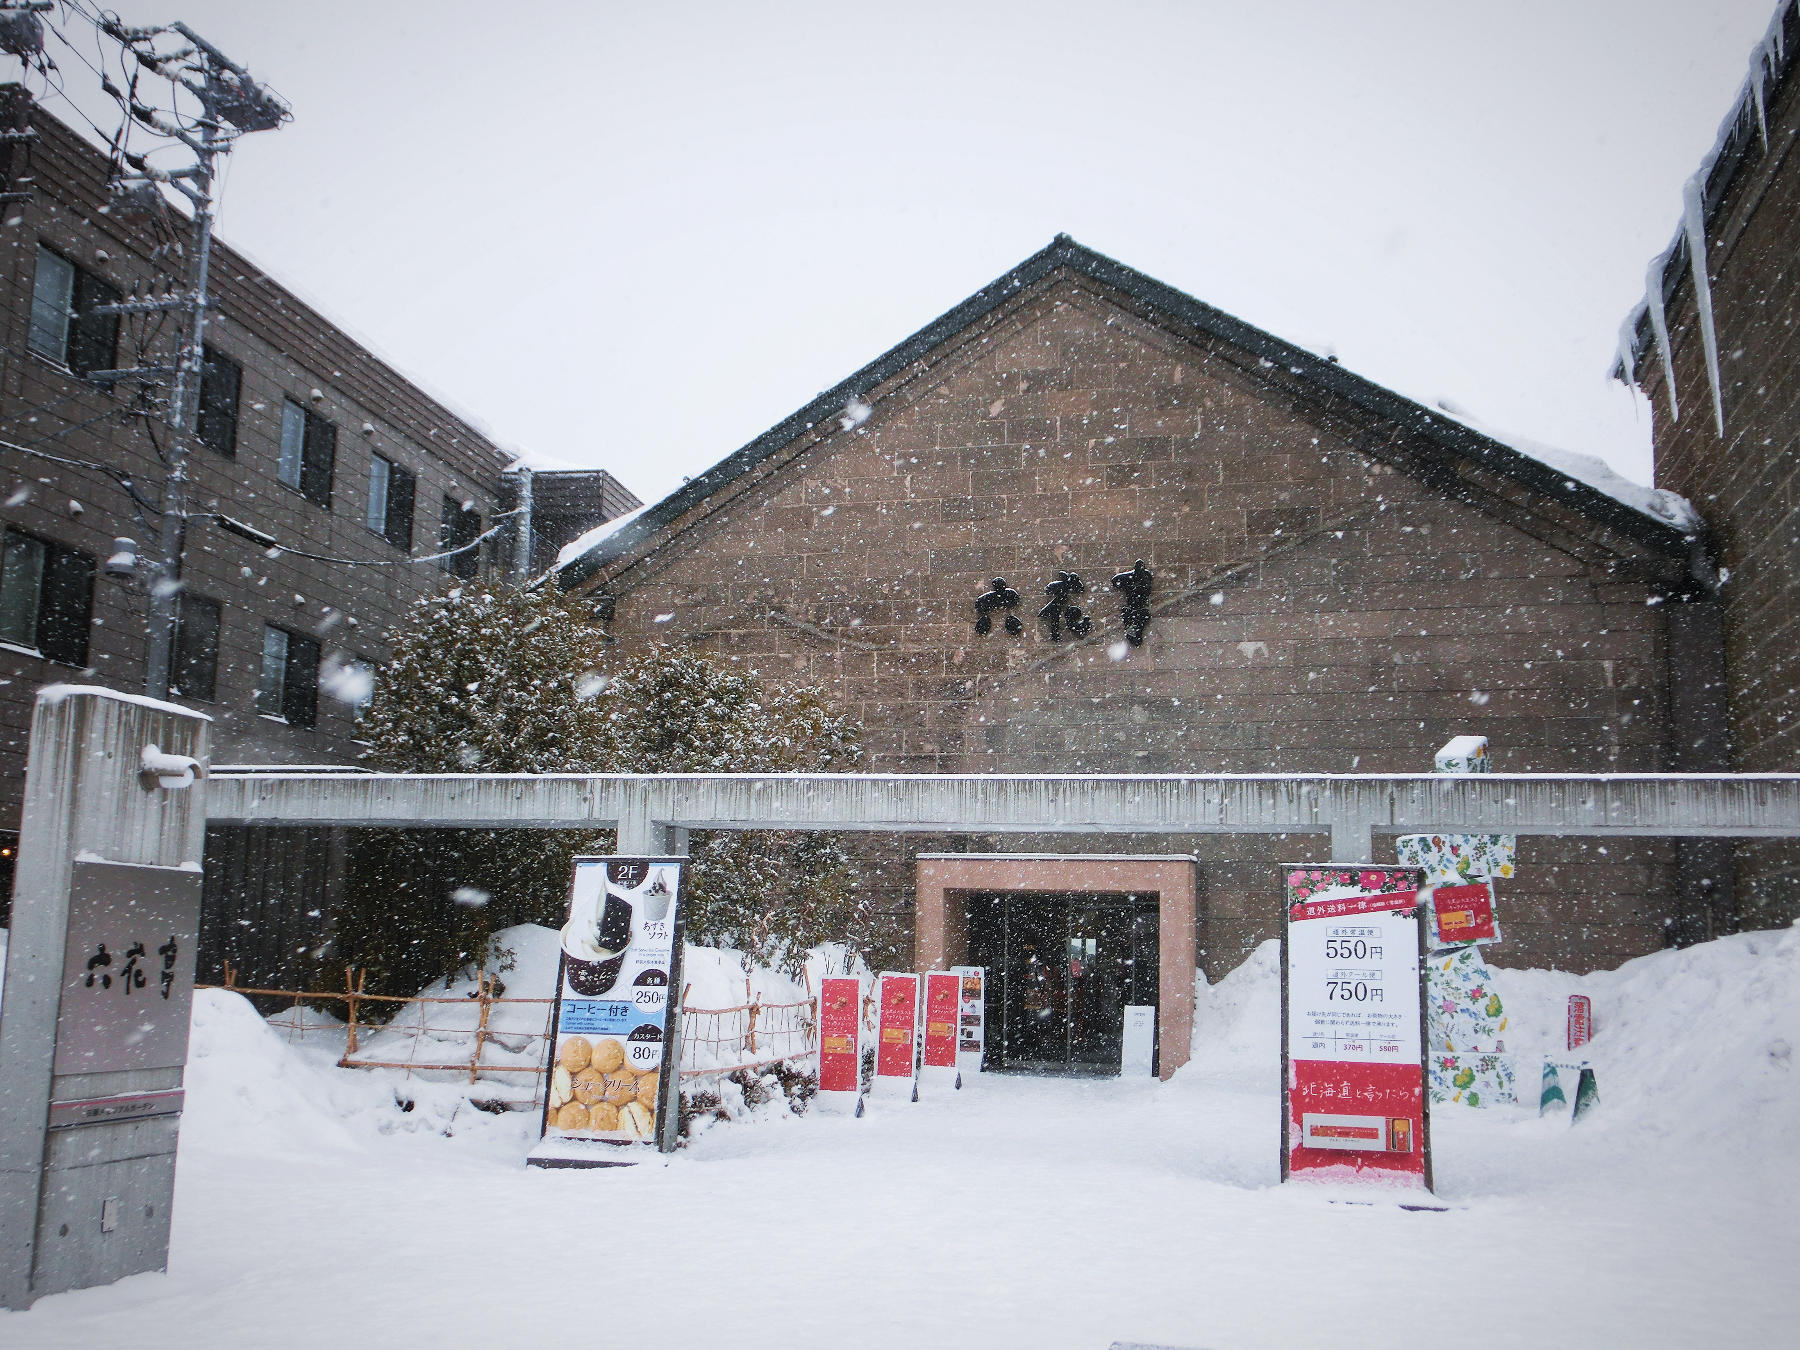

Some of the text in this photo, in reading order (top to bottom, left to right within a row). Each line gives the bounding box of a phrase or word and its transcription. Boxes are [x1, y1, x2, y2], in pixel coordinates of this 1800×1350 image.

[617, 865, 638, 879] 2F
[649, 931, 668, 940] ソフト
[1326, 940, 1382, 959] 550円
[85, 935, 178, 1000] 六花亭
[1326, 982, 1383, 1002] 750円
[567, 1003, 629, 1017] コーヒー付き
[571, 1078, 641, 1093] シュークリーム
